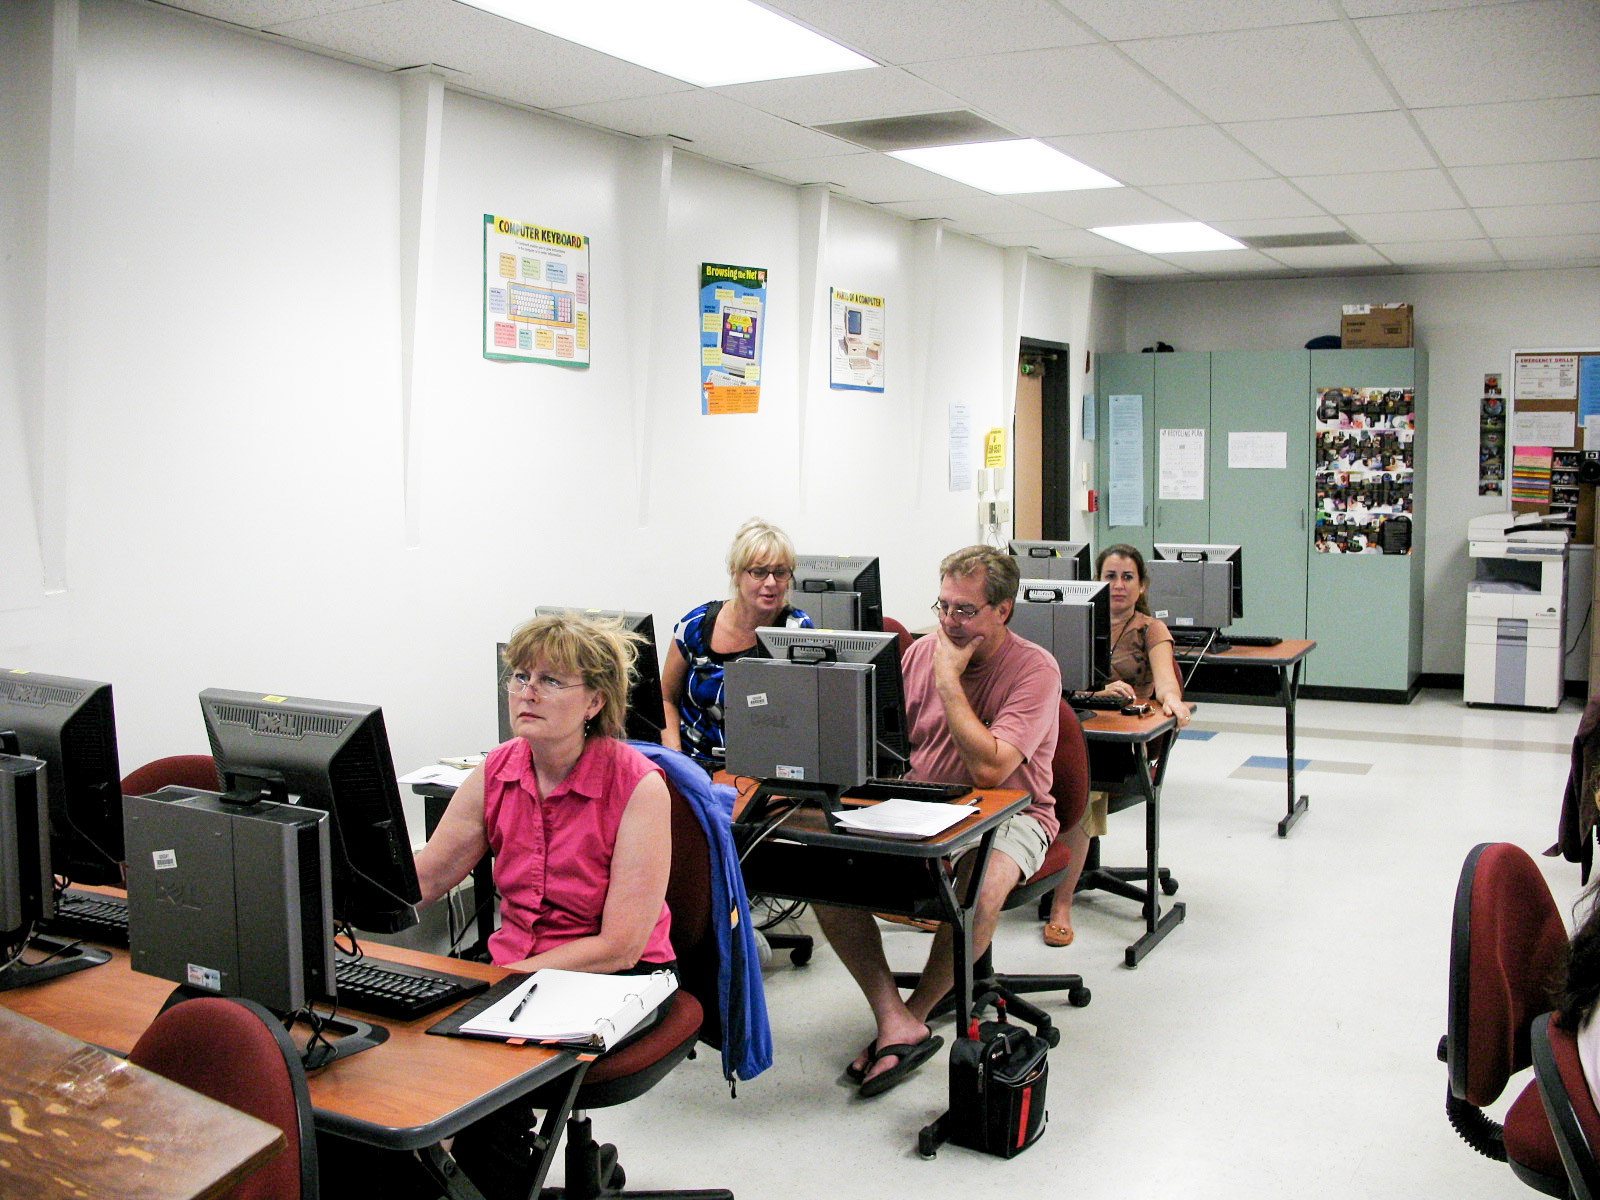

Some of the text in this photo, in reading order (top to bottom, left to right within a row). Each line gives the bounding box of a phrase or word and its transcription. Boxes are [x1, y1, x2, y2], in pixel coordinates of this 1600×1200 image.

[499, 219, 540, 241] COMPUTER
[541, 229, 582, 249] KEYBOARD
[706, 265, 757, 281] Browsing the Net
[859, 294, 881, 307] COMPUTER
[1191, 429, 1203, 437] PLAN
